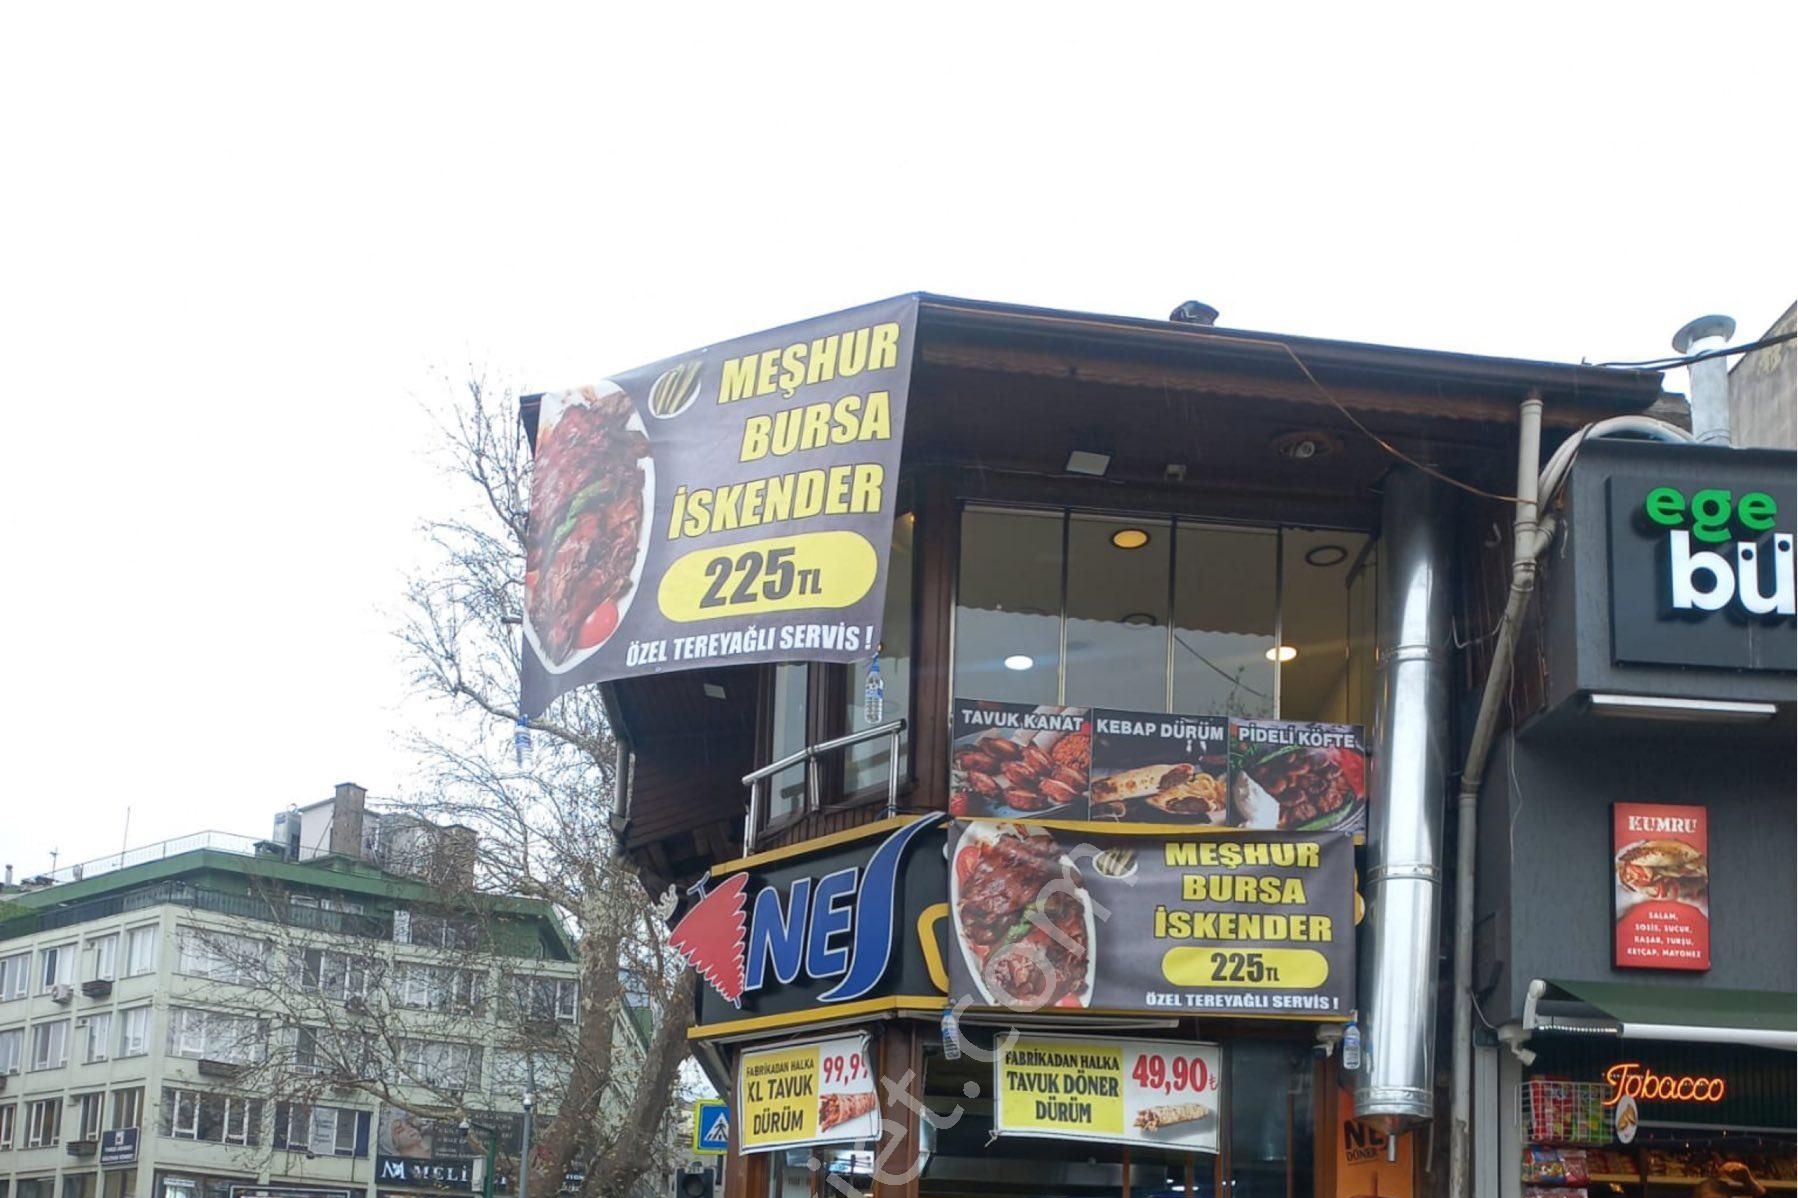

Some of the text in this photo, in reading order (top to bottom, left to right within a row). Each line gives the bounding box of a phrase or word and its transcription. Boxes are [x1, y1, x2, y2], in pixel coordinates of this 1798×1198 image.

[717, 322, 900, 405] MEŞHUR
[738, 391, 892, 463] BURSA
[667, 463, 885, 541] İSKENDER
[1646, 487, 1778, 543] ege
[625, 638, 669, 667] ÖZEL
[673, 626, 775, 664] TEREYAĞLI
[780, 622, 860, 652] SERVİS
[962, 709, 1084, 732] TAVUK KANAT
[1096, 719, 1224, 742] KEBAP DÜRÜM
[1238, 724, 1356, 748] PİDELİ KÖFTE
[1628, 816, 1698, 834] KUMRU
[1163, 842, 1320, 870] MEŞHUR
[1181, 875, 1307, 906] BURSA
[1153, 905, 1333, 942] İSKENDER
[1145, 992, 1182, 1007] ÖZEL
[1185, 992, 1270, 1009] TEREYAĞLI
[1272, 994, 1331, 1010] SERVİS
[746, 1058, 814, 1078] FABRİKADAN HALKA
[1005, 1048, 1120, 1071] FABRİKADAN HALKA
[747, 1074, 813, 1102] XL TAVUK
[1006, 1070, 1119, 1097] TAVUK DÖNER
[1602, 1063, 1725, 1106] Tobacco
[753, 1106, 804, 1136] DÜRÜM
[1035, 1096, 1092, 1123] DÜRÜM
